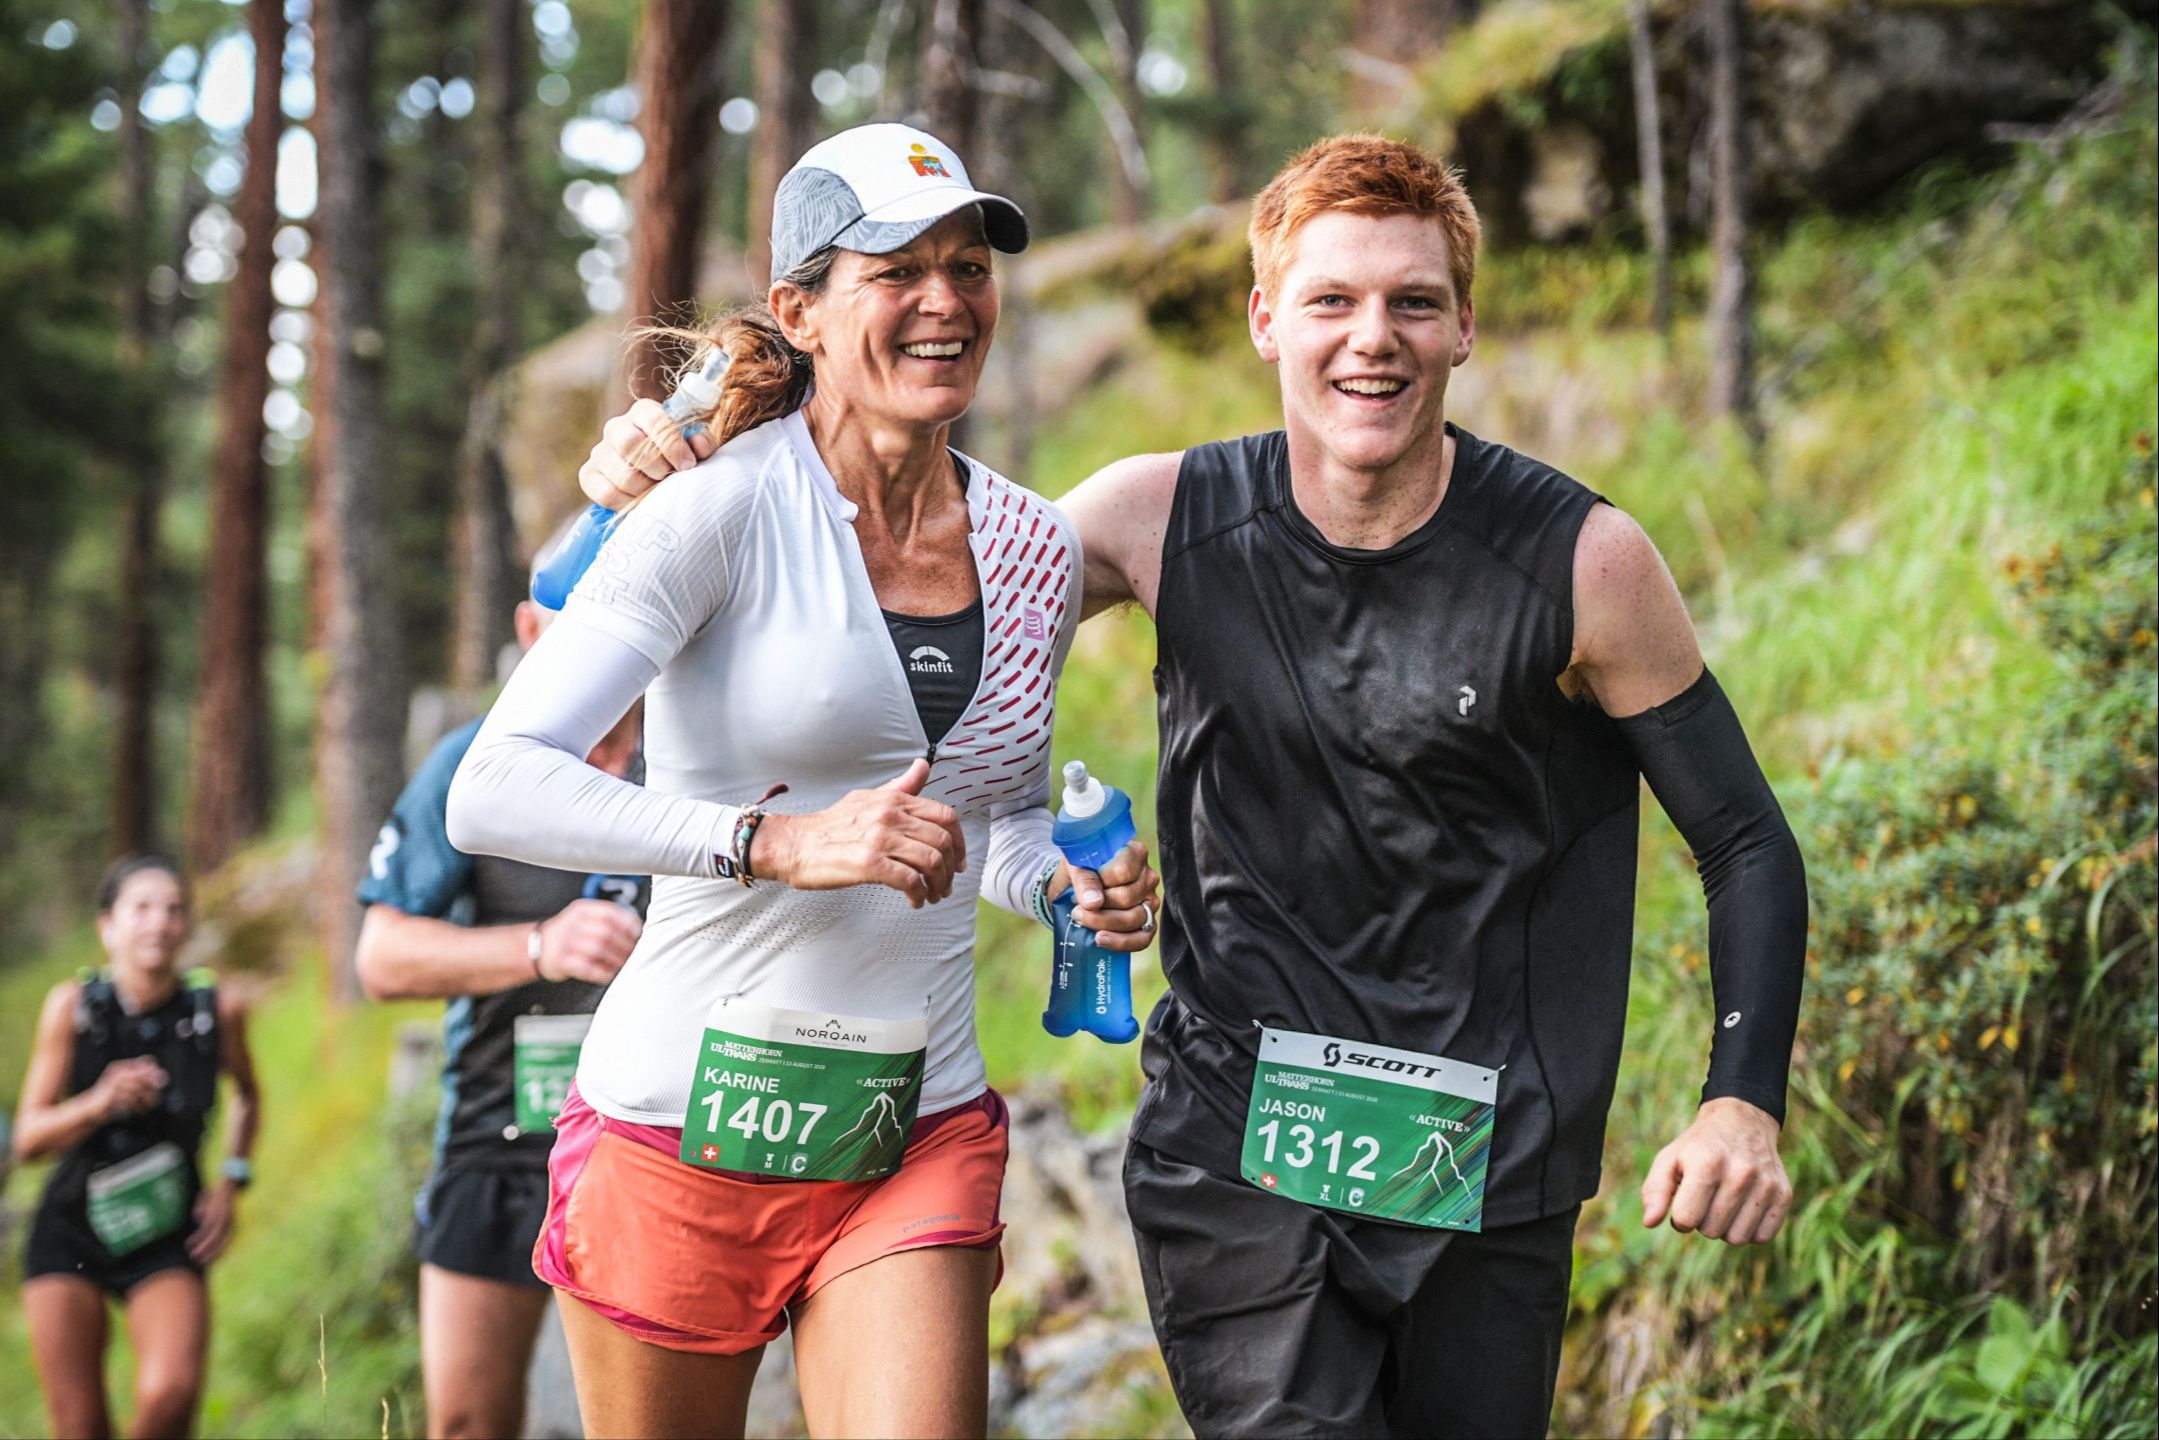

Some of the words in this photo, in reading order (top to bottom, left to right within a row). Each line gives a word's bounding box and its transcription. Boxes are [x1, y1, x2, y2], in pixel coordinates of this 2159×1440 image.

[910, 661, 954, 673] skinfit
[1097, 961, 1107, 1005] HydraPak
[795, 1027, 867, 1043] NORQAIN
[710, 1042, 758, 1062] ULTRAKS
[724, 1041, 784, 1057] MATTERHORN
[1344, 1053, 1442, 1078] SCOTT
[704, 1066, 780, 1094] KARINE
[1264, 1074, 1310, 1090] ULTRAKS
[1278, 1071, 1335, 1087] MATTERHORN
[701, 1090, 828, 1145] 1407
[1259, 1098, 1327, 1122] JASON
[1257, 1120, 1380, 1181] 1312
[1319, 1192, 1330, 1202] XL
